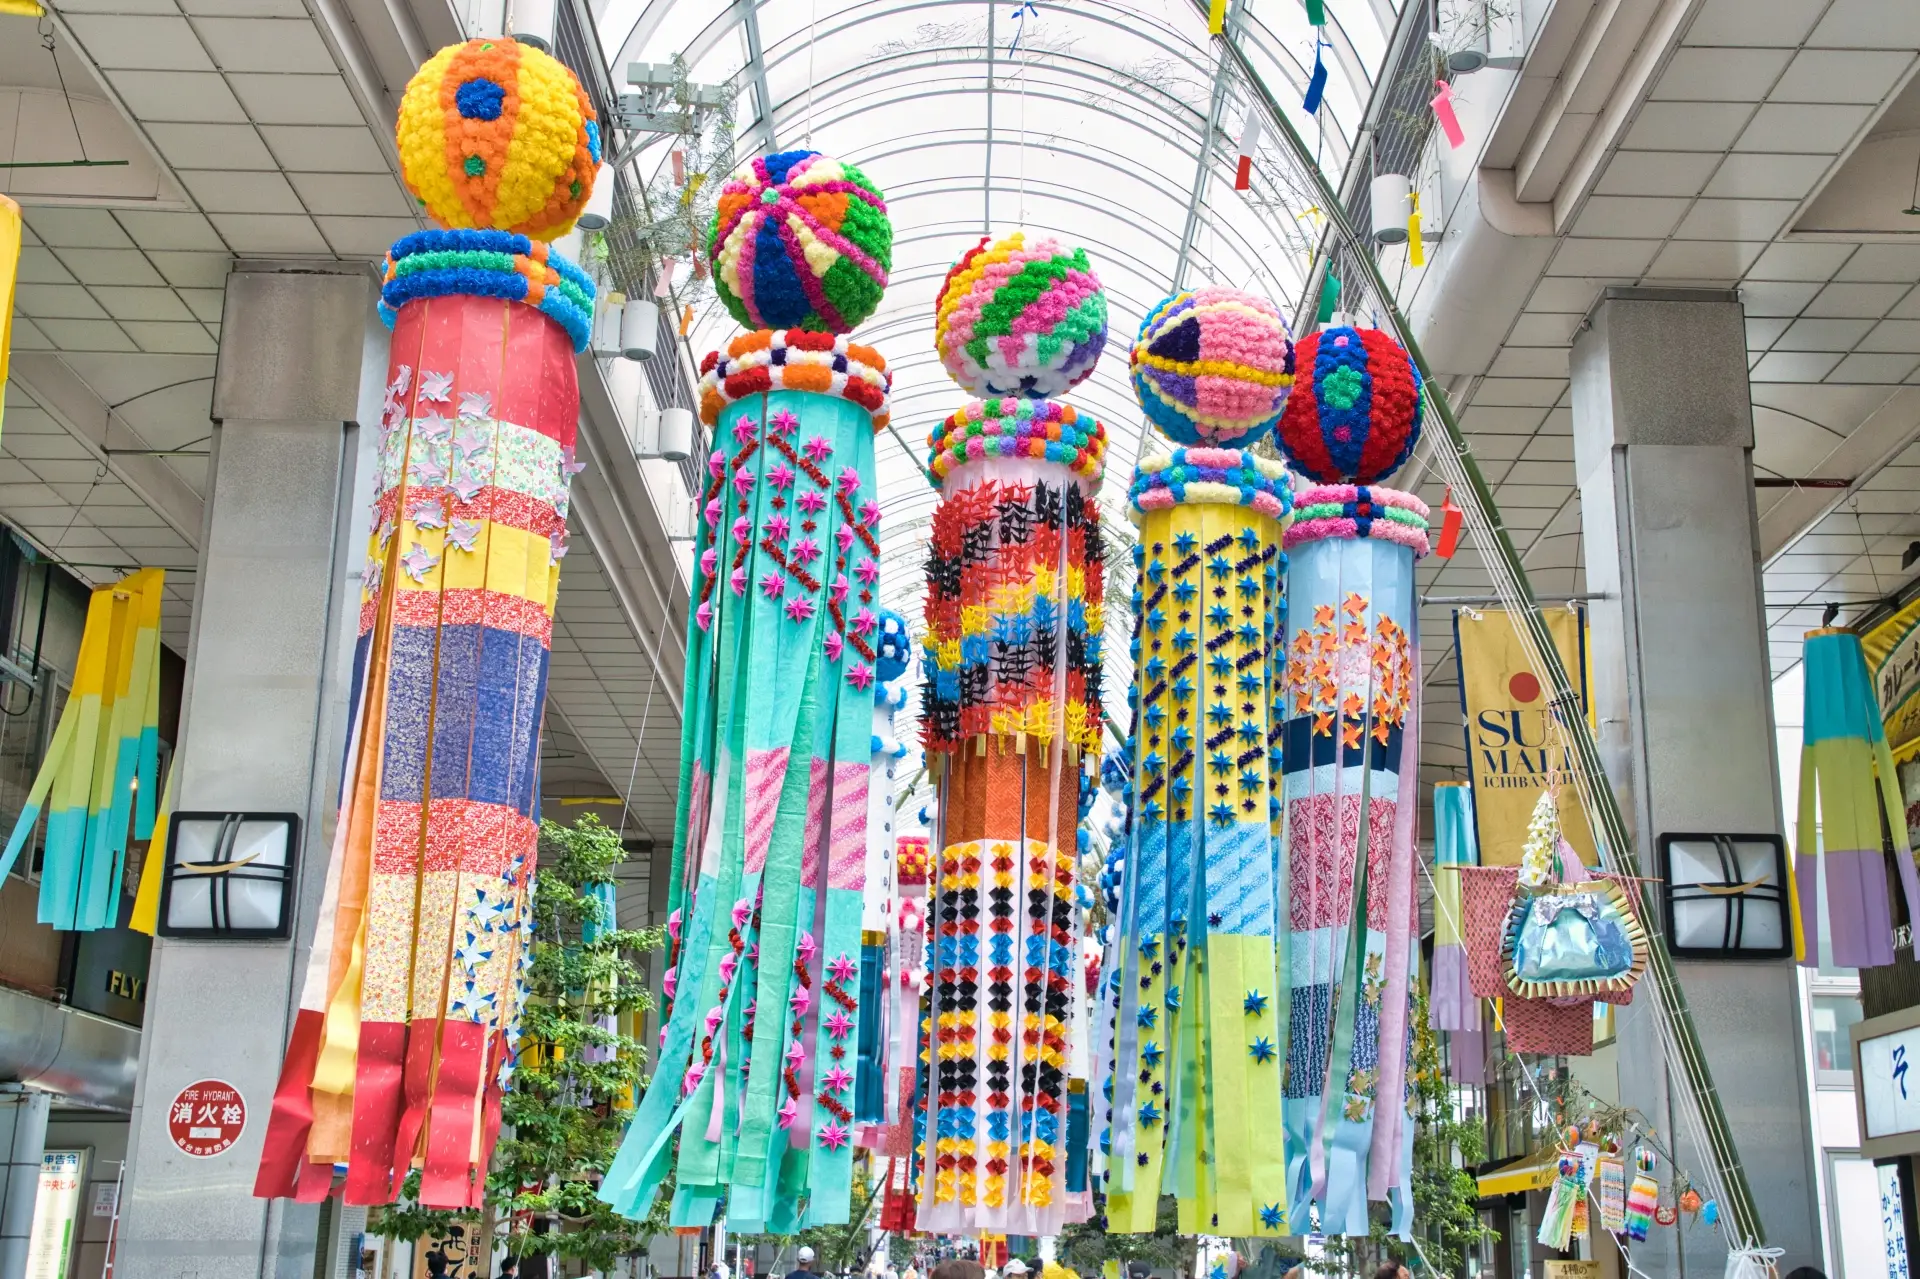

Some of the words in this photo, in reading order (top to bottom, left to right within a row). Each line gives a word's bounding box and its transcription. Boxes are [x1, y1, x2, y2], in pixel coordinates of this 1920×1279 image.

[109, 969, 141, 1001] FLY
[184, 1090, 200, 1101] FIRE
[202, 1090, 236, 1101] HYDRANT
[172, 1102, 242, 1125] 消火栓
